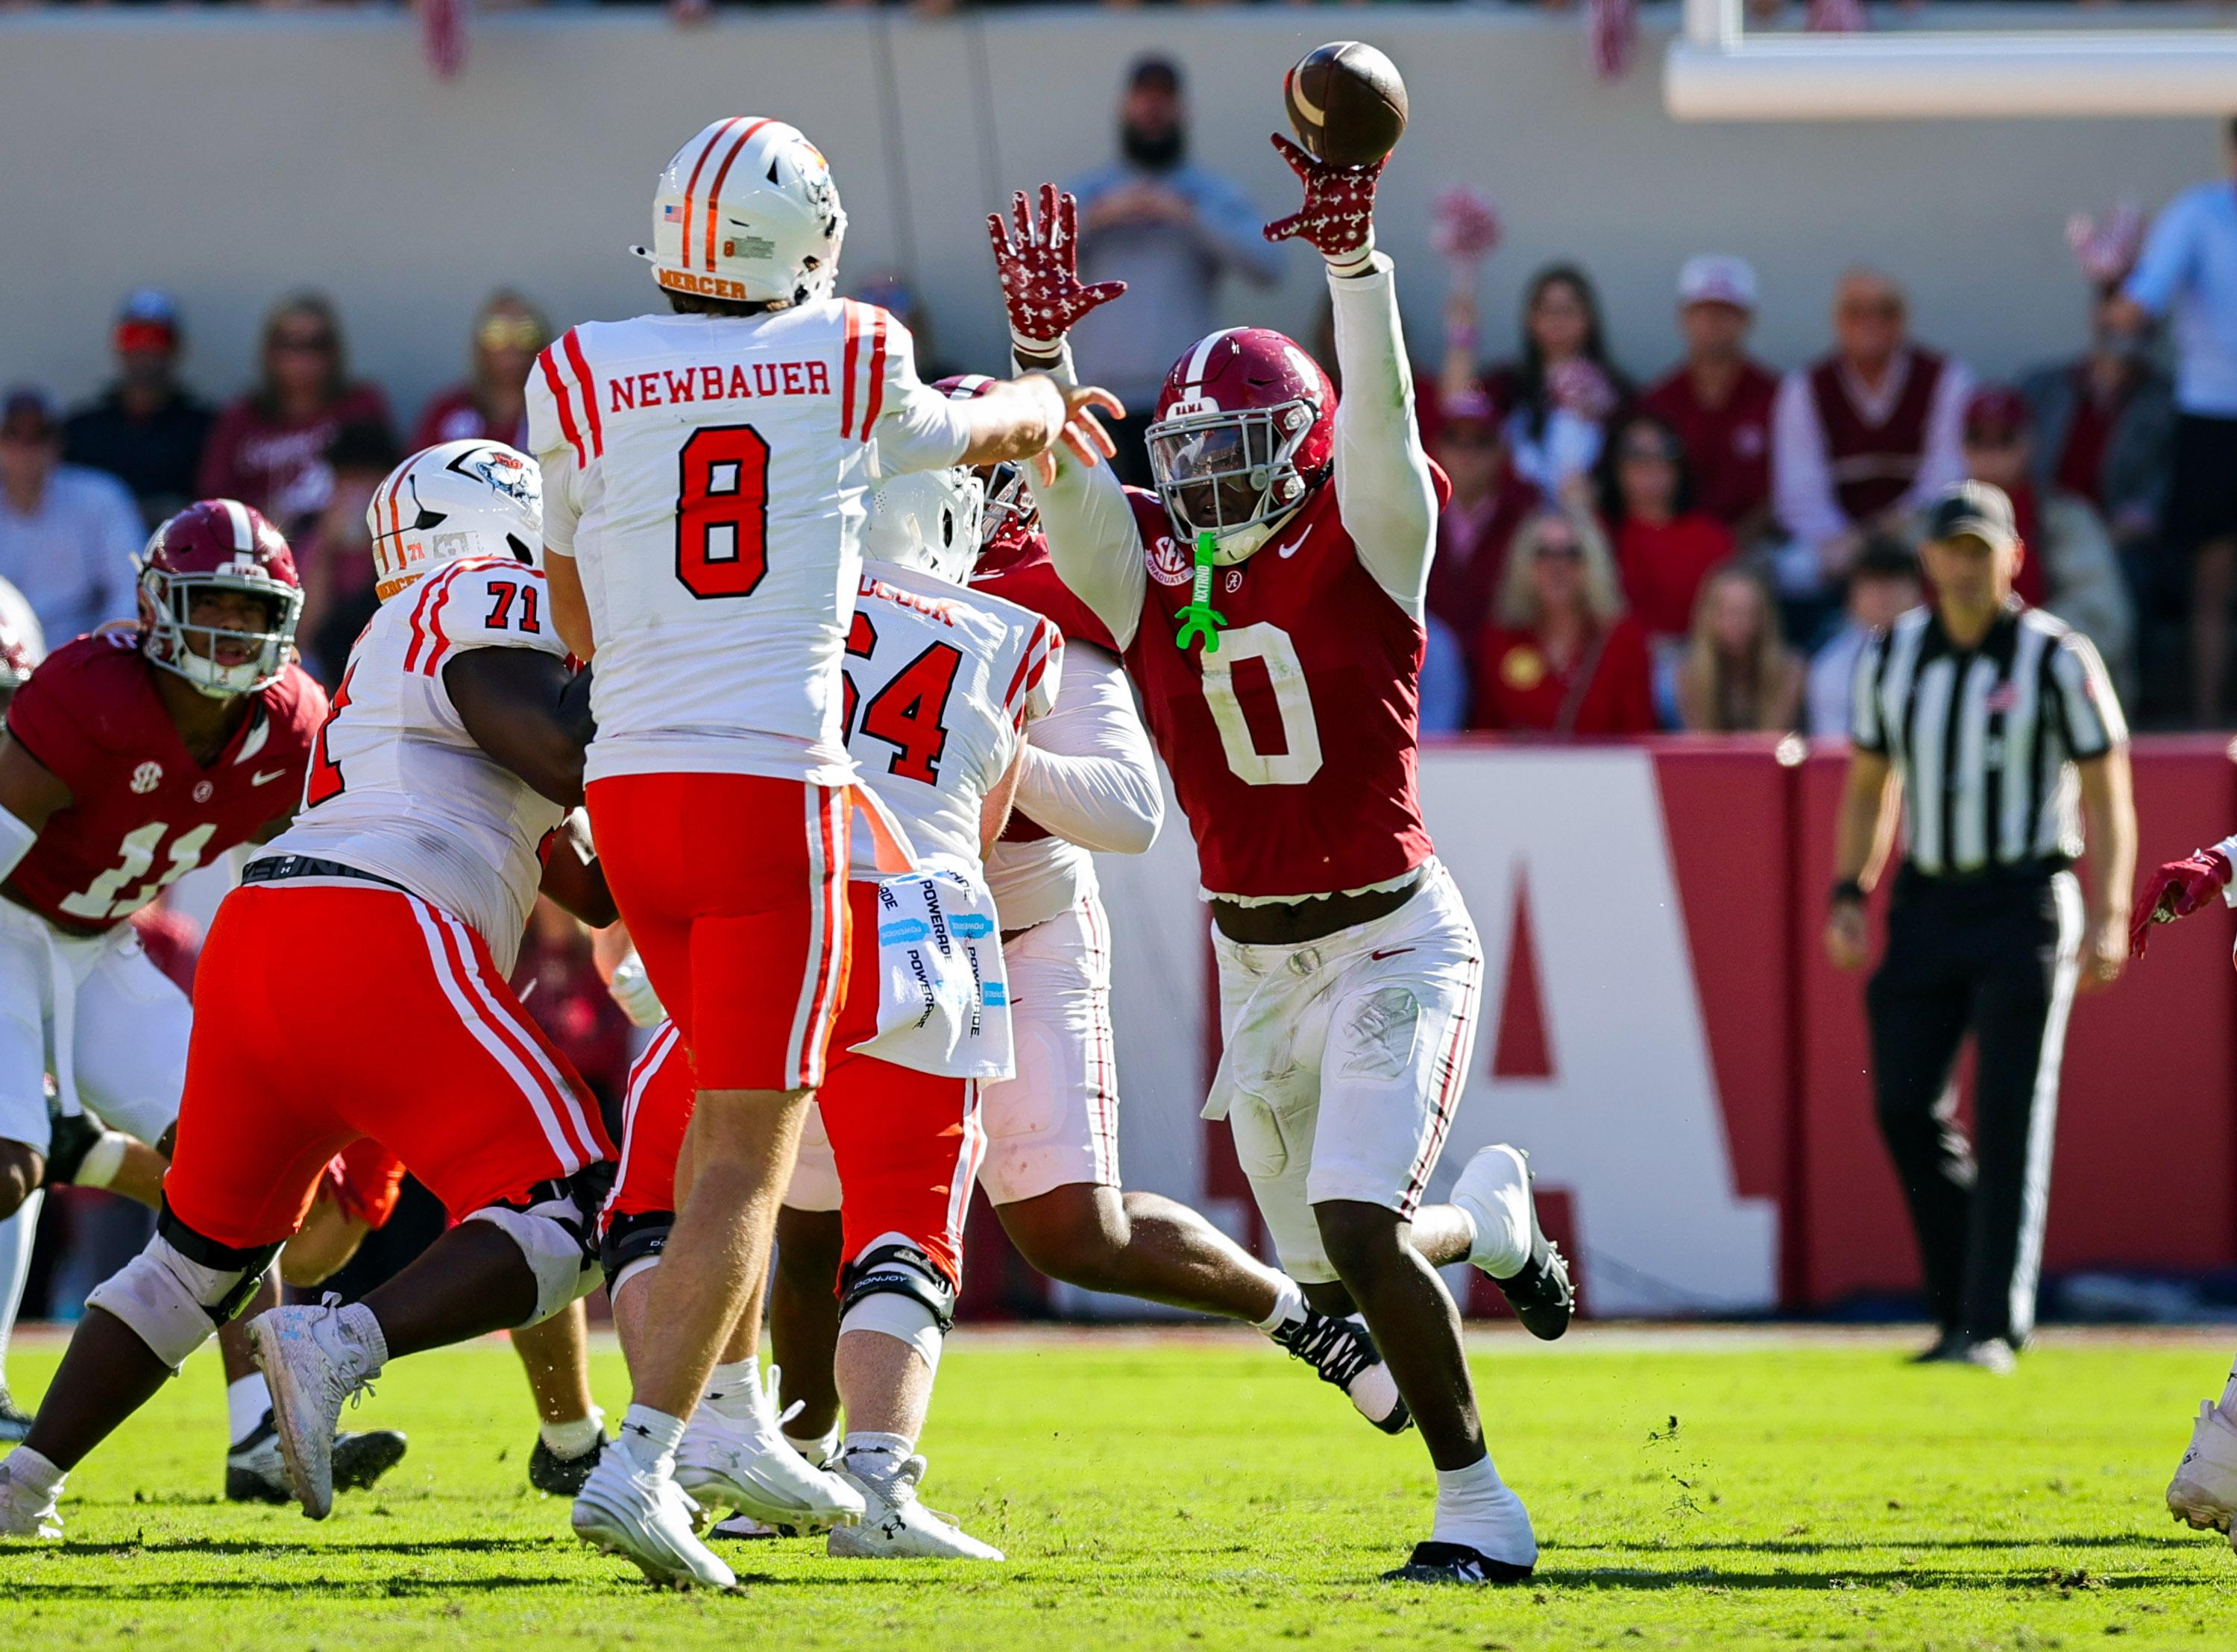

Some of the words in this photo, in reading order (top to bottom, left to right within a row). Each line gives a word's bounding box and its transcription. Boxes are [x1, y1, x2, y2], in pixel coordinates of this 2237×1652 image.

[658, 267, 747, 300] MERCER
[610, 360, 831, 413] NEWBAUER
[1176, 402, 1204, 415] BAMA
[675, 423, 771, 600] 8
[407, 543, 425, 561] 71
[1148, 558, 1187, 584] GRADUATE
[1193, 564, 1209, 603] NXTRND
[485, 581, 540, 634] 71
[1200, 621, 1324, 786] 0
[58, 822, 218, 920] 11
[919, 879, 954, 965] POWERADE
[854, 1276, 909, 1290] DONJOY
